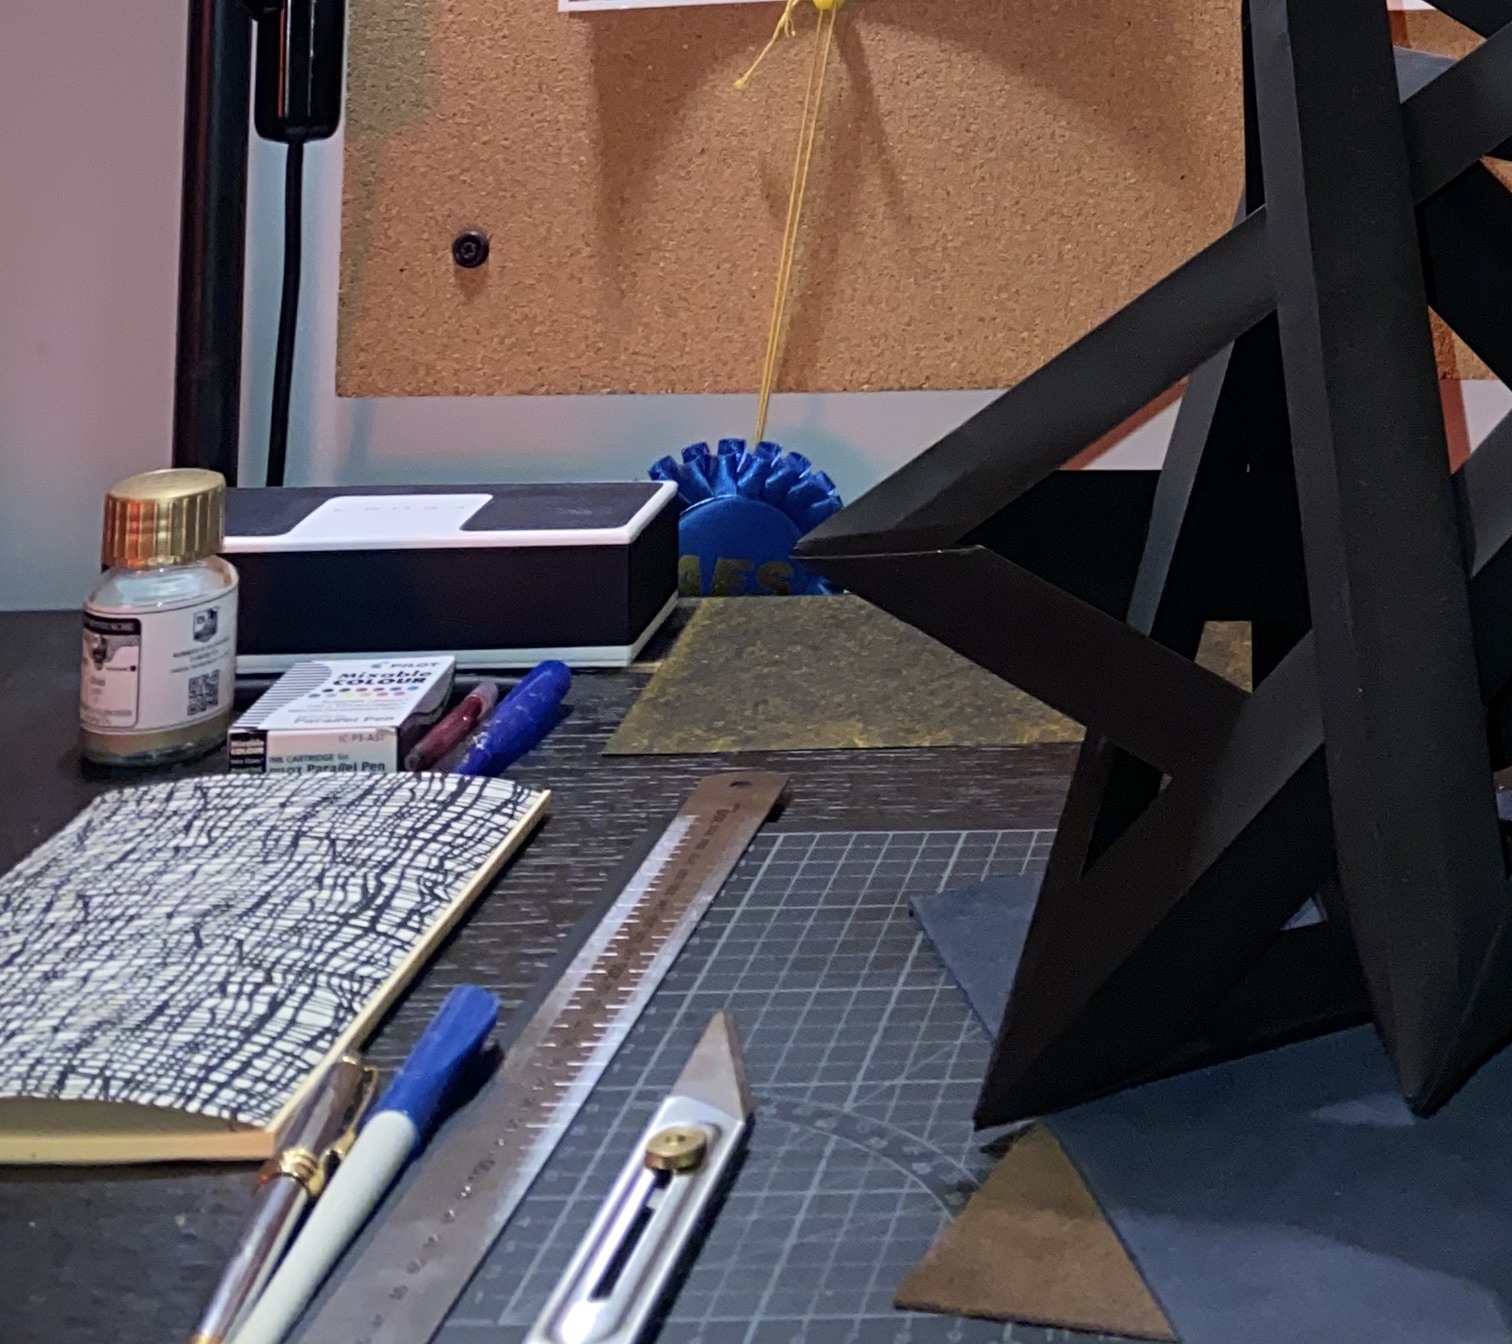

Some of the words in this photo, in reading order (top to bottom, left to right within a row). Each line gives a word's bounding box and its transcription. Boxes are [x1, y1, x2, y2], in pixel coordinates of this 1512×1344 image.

[338, 670, 432, 679] Mixable
[333, 678, 427, 686] COLOUR
[361, 761, 386, 773] Pen
